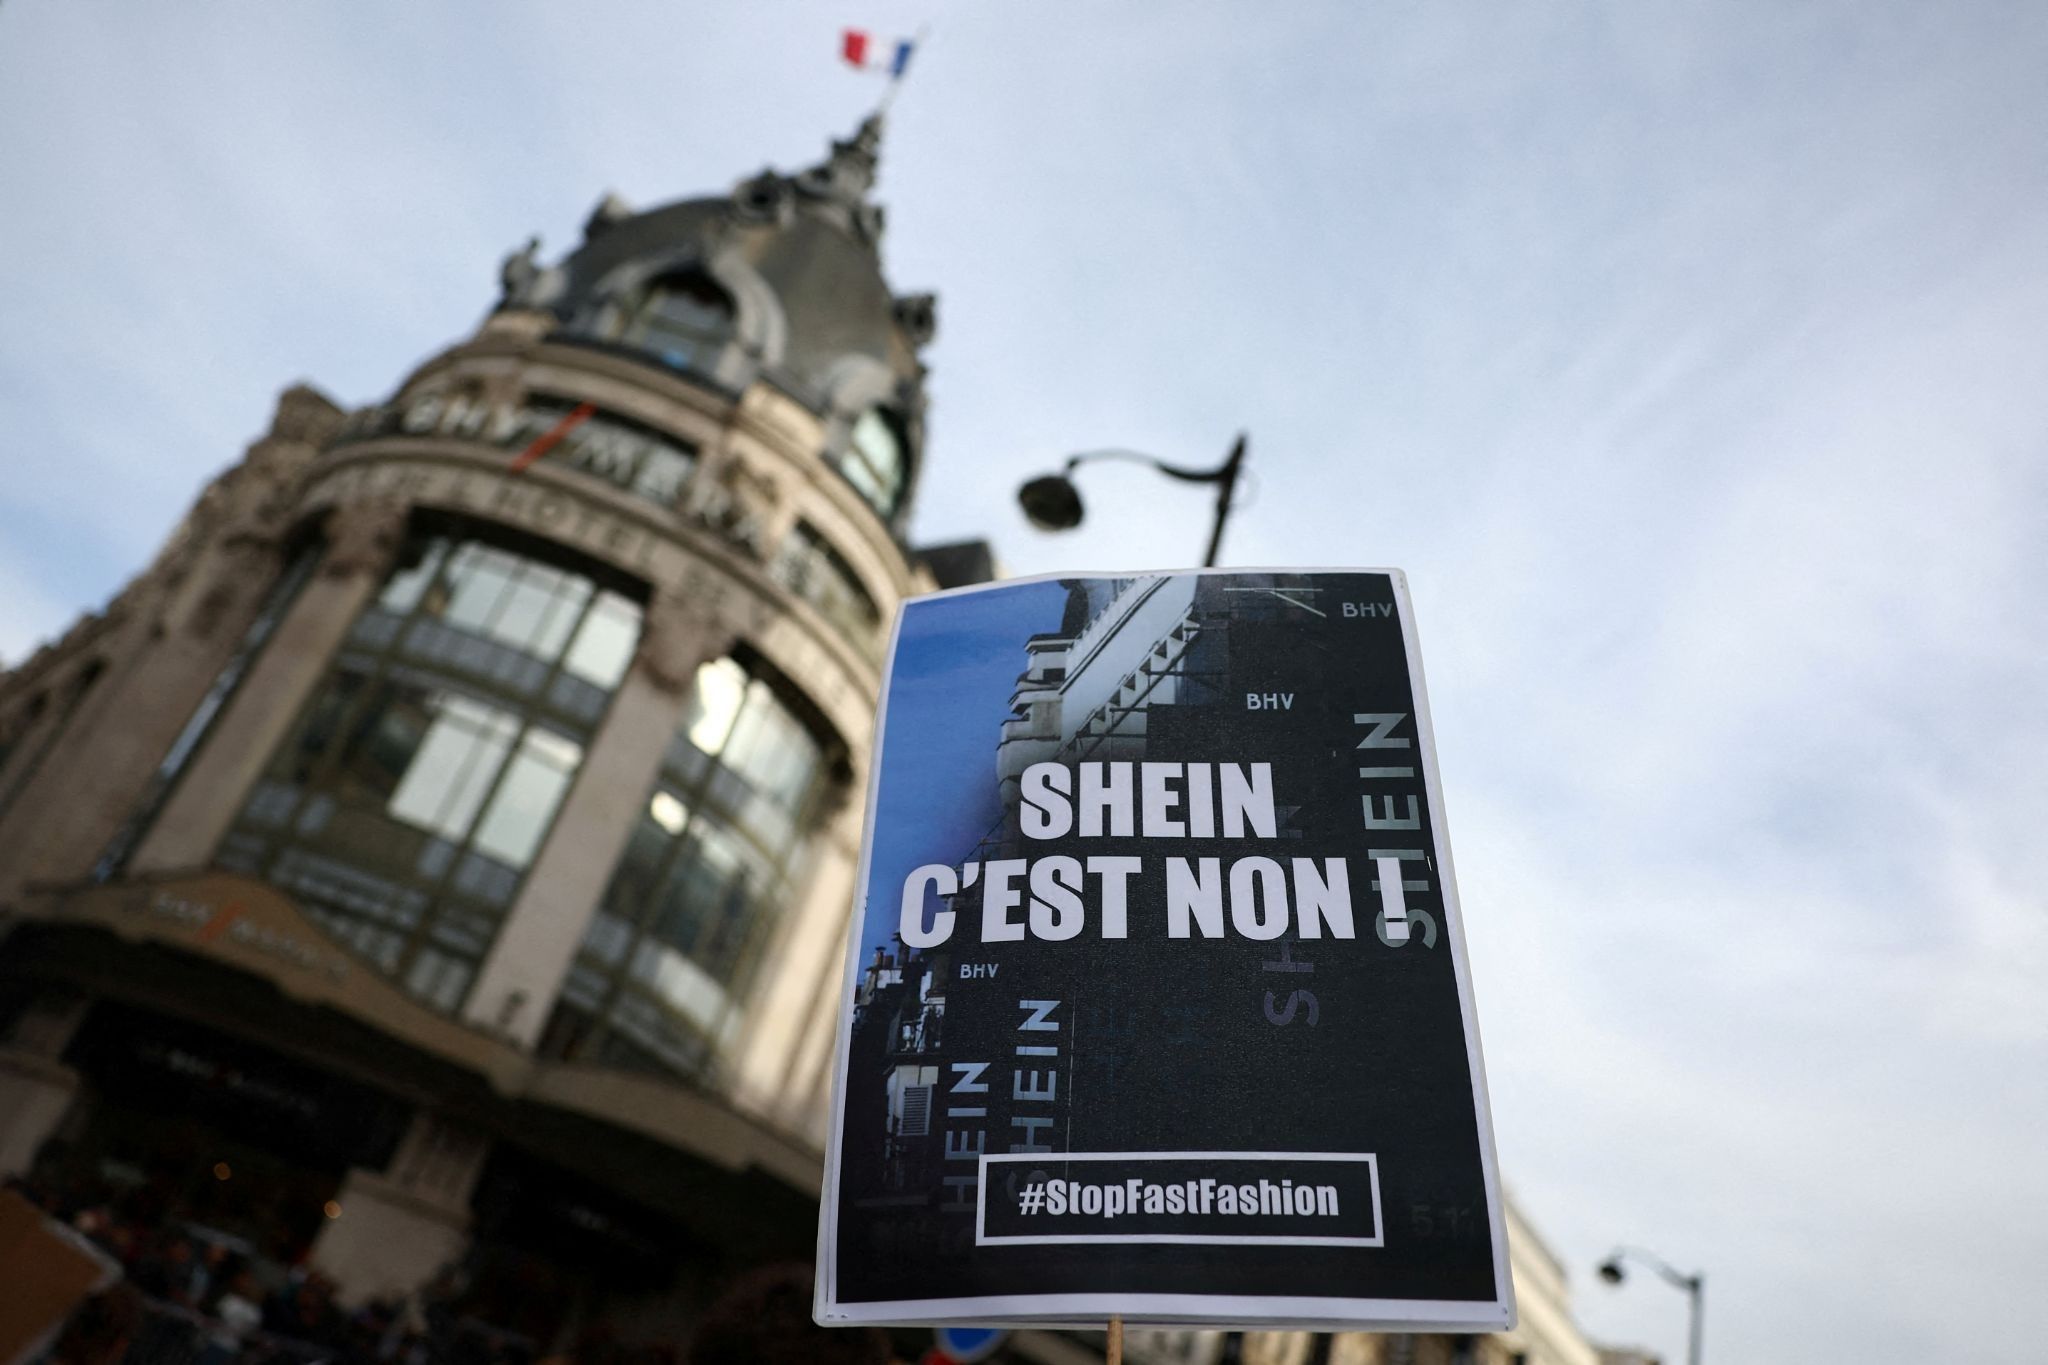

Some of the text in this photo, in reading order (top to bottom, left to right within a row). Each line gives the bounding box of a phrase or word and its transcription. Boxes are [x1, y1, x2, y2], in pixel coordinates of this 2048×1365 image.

[1342, 602, 1393, 619] BHV
[1246, 692, 1295, 711] BHV
[1020, 761, 1278, 840] SHEIN
[899, 855, 1411, 949] C'EST NON !
[960, 963, 999, 979] BHV
[1018, 1178, 1340, 1218] #StopFastFashion
